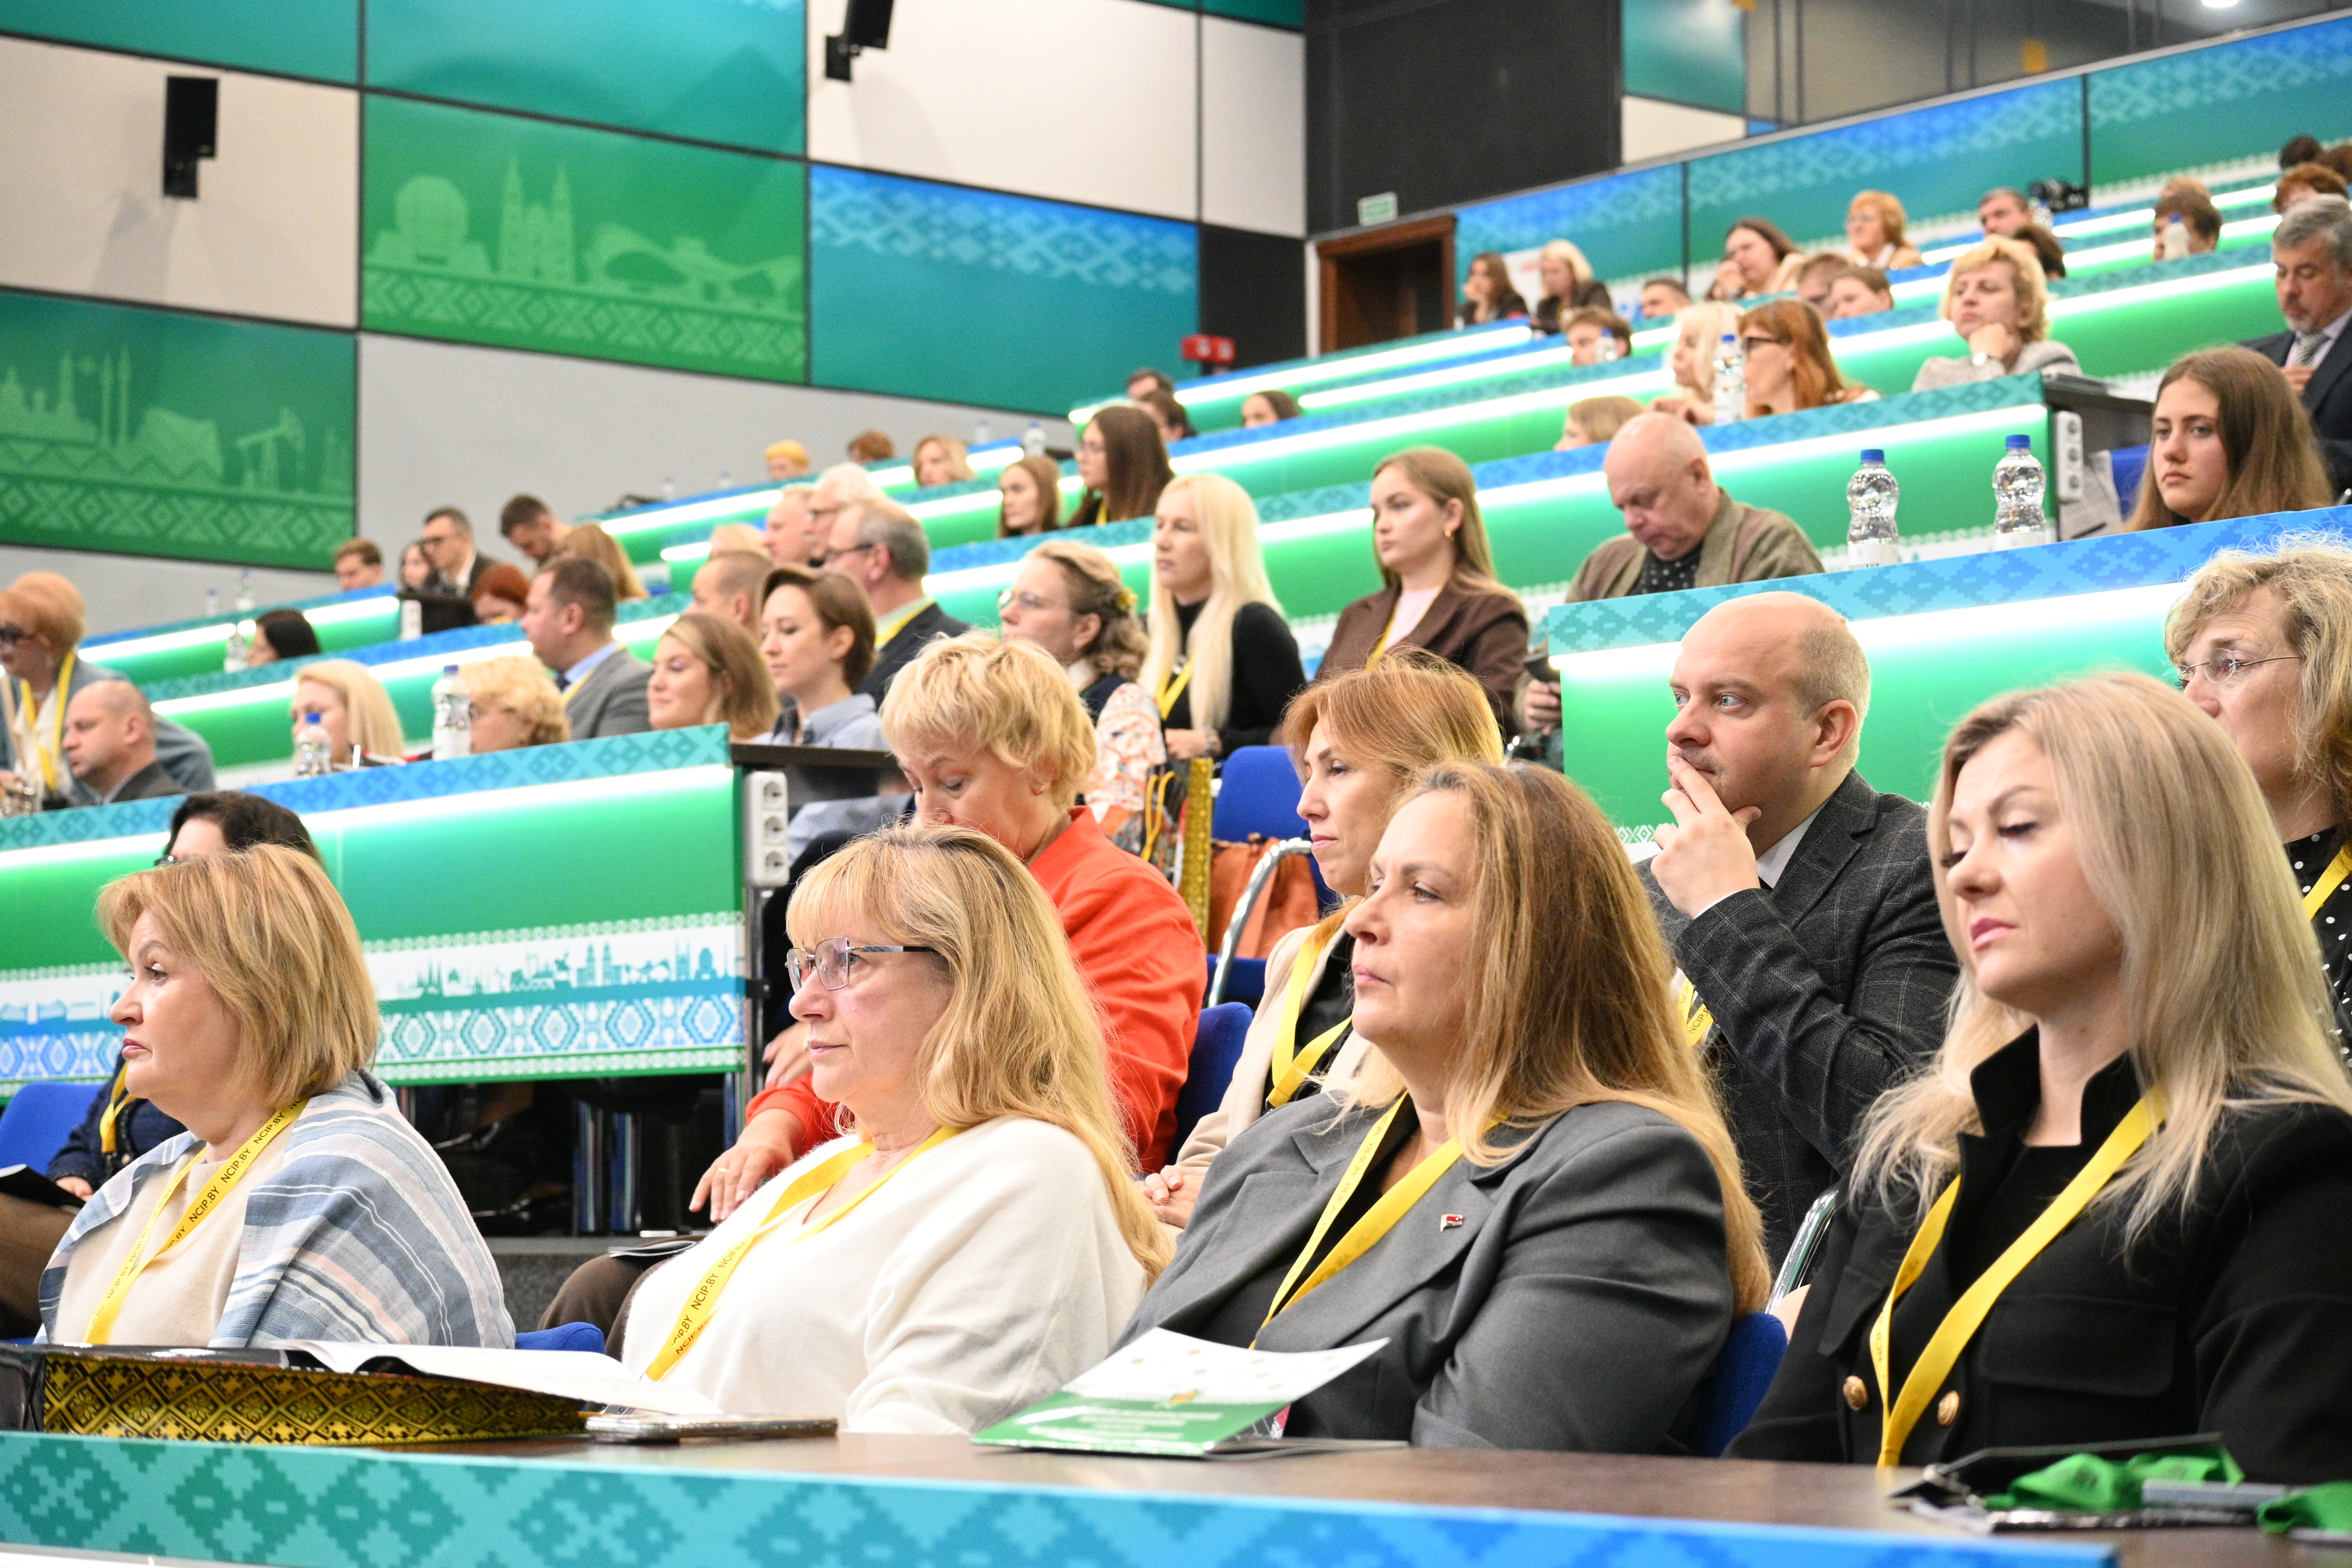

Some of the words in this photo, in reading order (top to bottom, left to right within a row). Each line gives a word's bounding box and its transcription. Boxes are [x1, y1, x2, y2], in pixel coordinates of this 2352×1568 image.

[189, 1186, 219, 1222] NCIP.BY
[220, 1148, 251, 1183] NCIP.BY
[253, 1112, 285, 1144] NCIP.BY
[107, 1266, 129, 1298] NCIP.BY
[671, 1315, 692, 1346] CIP.BY
[691, 1273, 718, 1310] NCIP.BY
[718, 1242, 746, 1268] NCIP.BY
[676, 1319, 708, 1355] NCIP.BY
